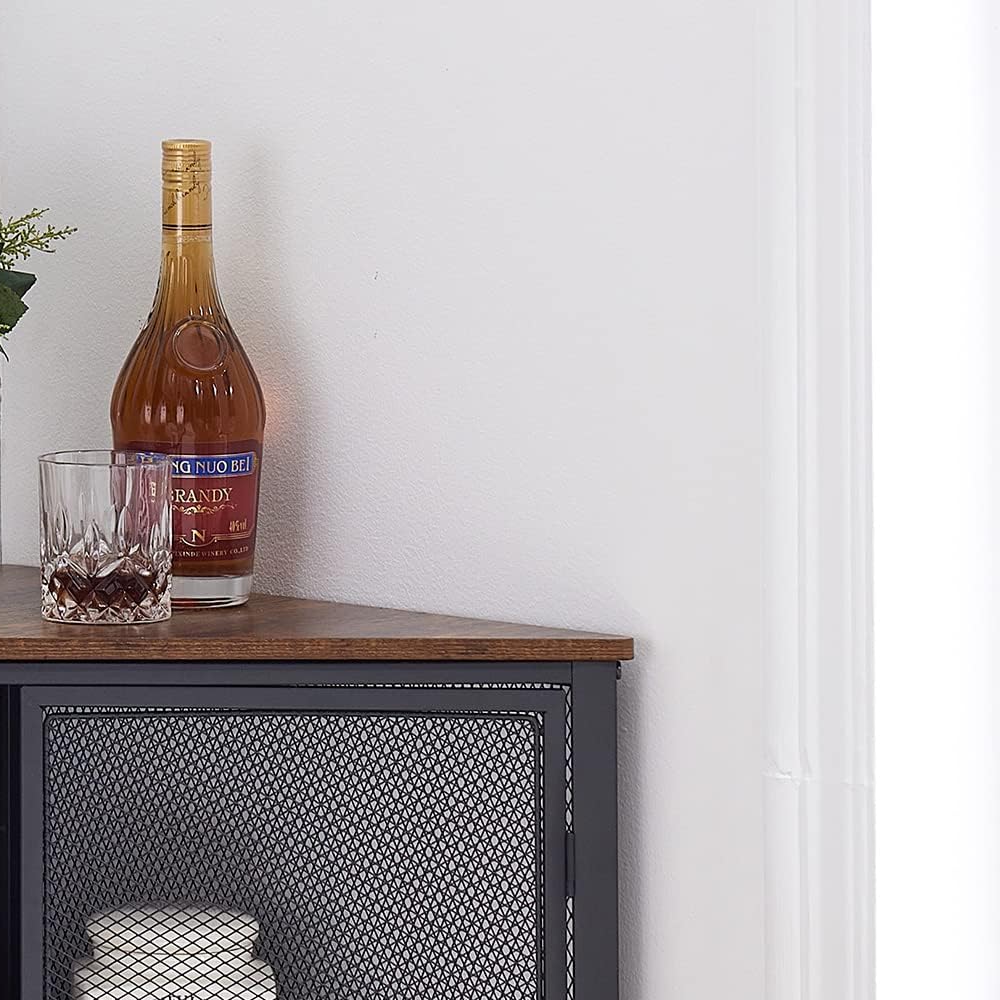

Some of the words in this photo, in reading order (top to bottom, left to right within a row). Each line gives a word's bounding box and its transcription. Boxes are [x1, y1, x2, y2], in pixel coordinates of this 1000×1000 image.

[171, 460, 191, 474] NG
[195, 460, 227, 474] NUO
[231, 456, 250, 472] BEI
[191, 529, 206, 543] N
